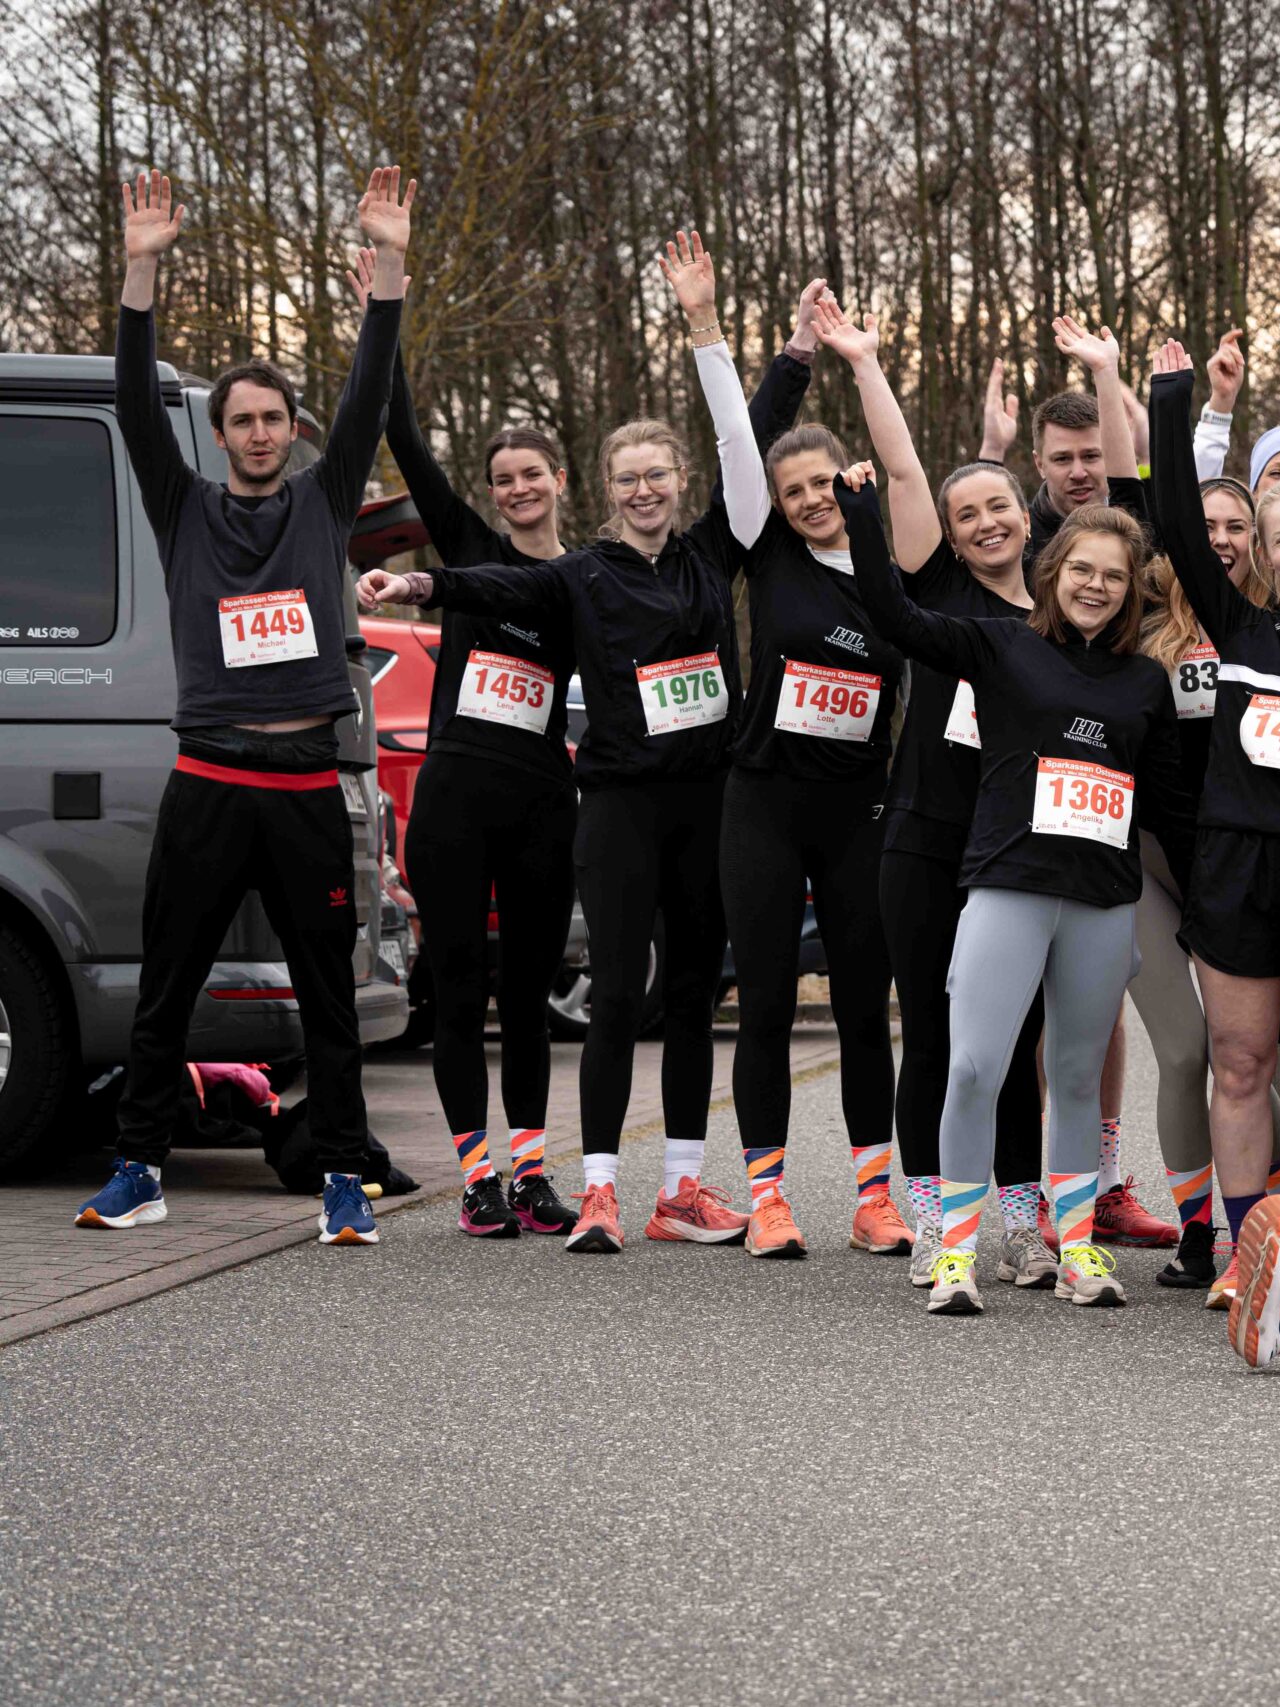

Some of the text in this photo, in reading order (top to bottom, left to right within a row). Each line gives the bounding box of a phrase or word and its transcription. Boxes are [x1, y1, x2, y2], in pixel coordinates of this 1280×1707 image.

[223, 596, 267, 608] Sparkassen
[267, 592, 300, 601] Ostseelauf
[231, 607, 304, 642] 1449
[500, 623, 526, 639] TRAINING
[258, 639, 286, 648] Michael
[824, 636, 868, 657] TRAINING CLUB
[831, 626, 864, 650] HL
[475, 652, 516, 666] Sparkassen
[1192, 646, 1216, 654] kasse
[0, 668, 112, 684] EACH
[642, 662, 684, 676] Sparkassen
[684, 655, 716, 666] Ostseelauf
[792, 663, 836, 677] Sparkassen
[838, 672, 876, 684] Ostseelauf
[1179, 661, 1218, 692] 83
[475, 668, 545, 708] 1453
[652, 670, 720, 708] 1976
[680, 704, 703, 712] Hannah
[794, 680, 869, 718] 1496
[817, 714, 836, 724] Lotte
[1069, 717, 1104, 740] HL
[1062, 732, 1107, 748] TRAINING CLUB
[1045, 760, 1094, 773] Sparkassen
[1096, 766, 1130, 783] Ostseelauf
[1049, 777, 1124, 820] 1368
[1070, 812, 1104, 824] Angelika
